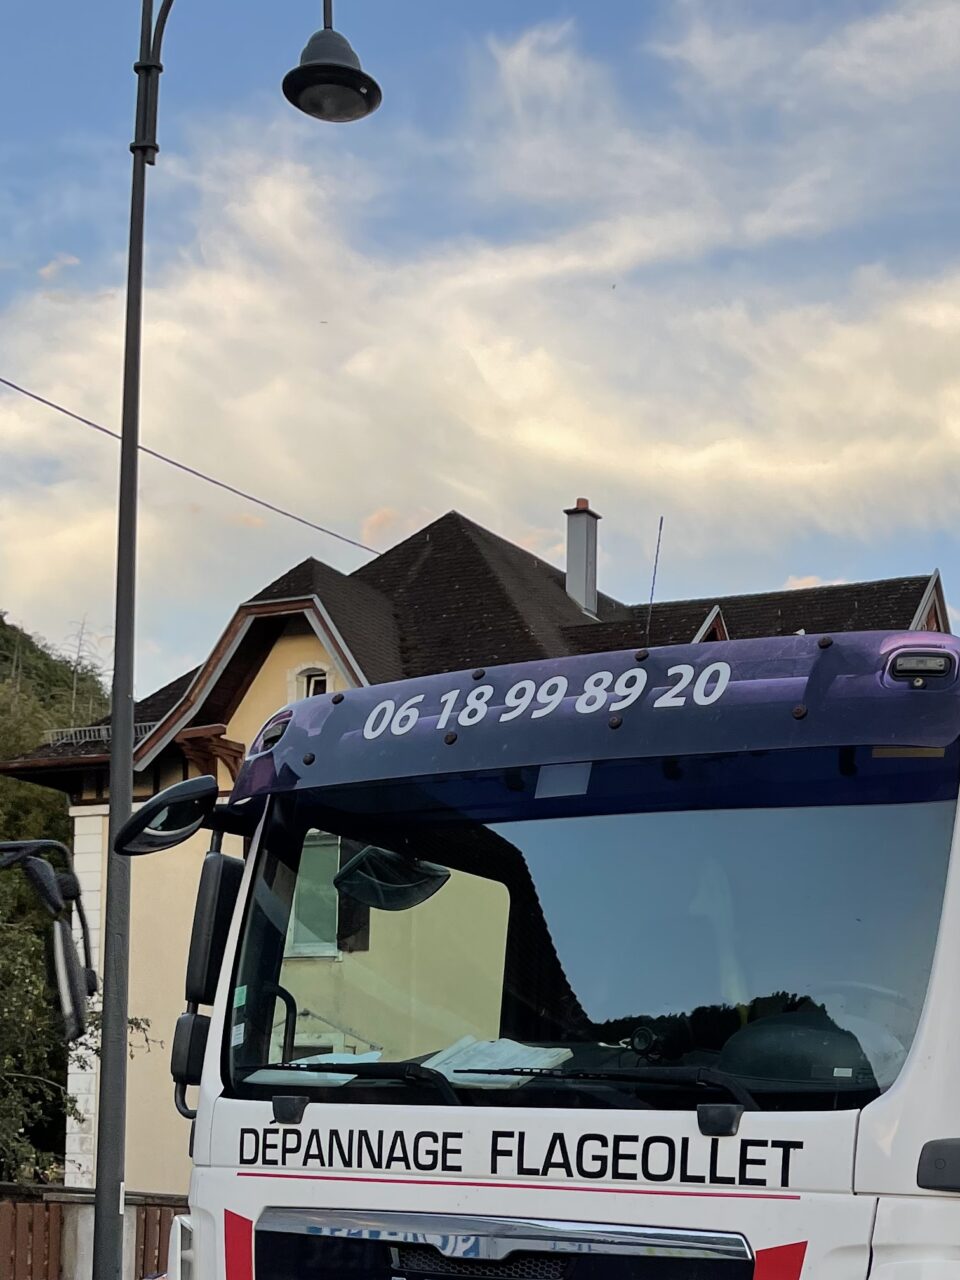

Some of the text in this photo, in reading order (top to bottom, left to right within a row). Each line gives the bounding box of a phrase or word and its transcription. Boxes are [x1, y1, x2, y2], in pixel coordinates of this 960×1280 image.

[363, 661, 731, 740] 06 18 99 89 20
[490, 1130, 804, 1187] FLAGEOLLET
